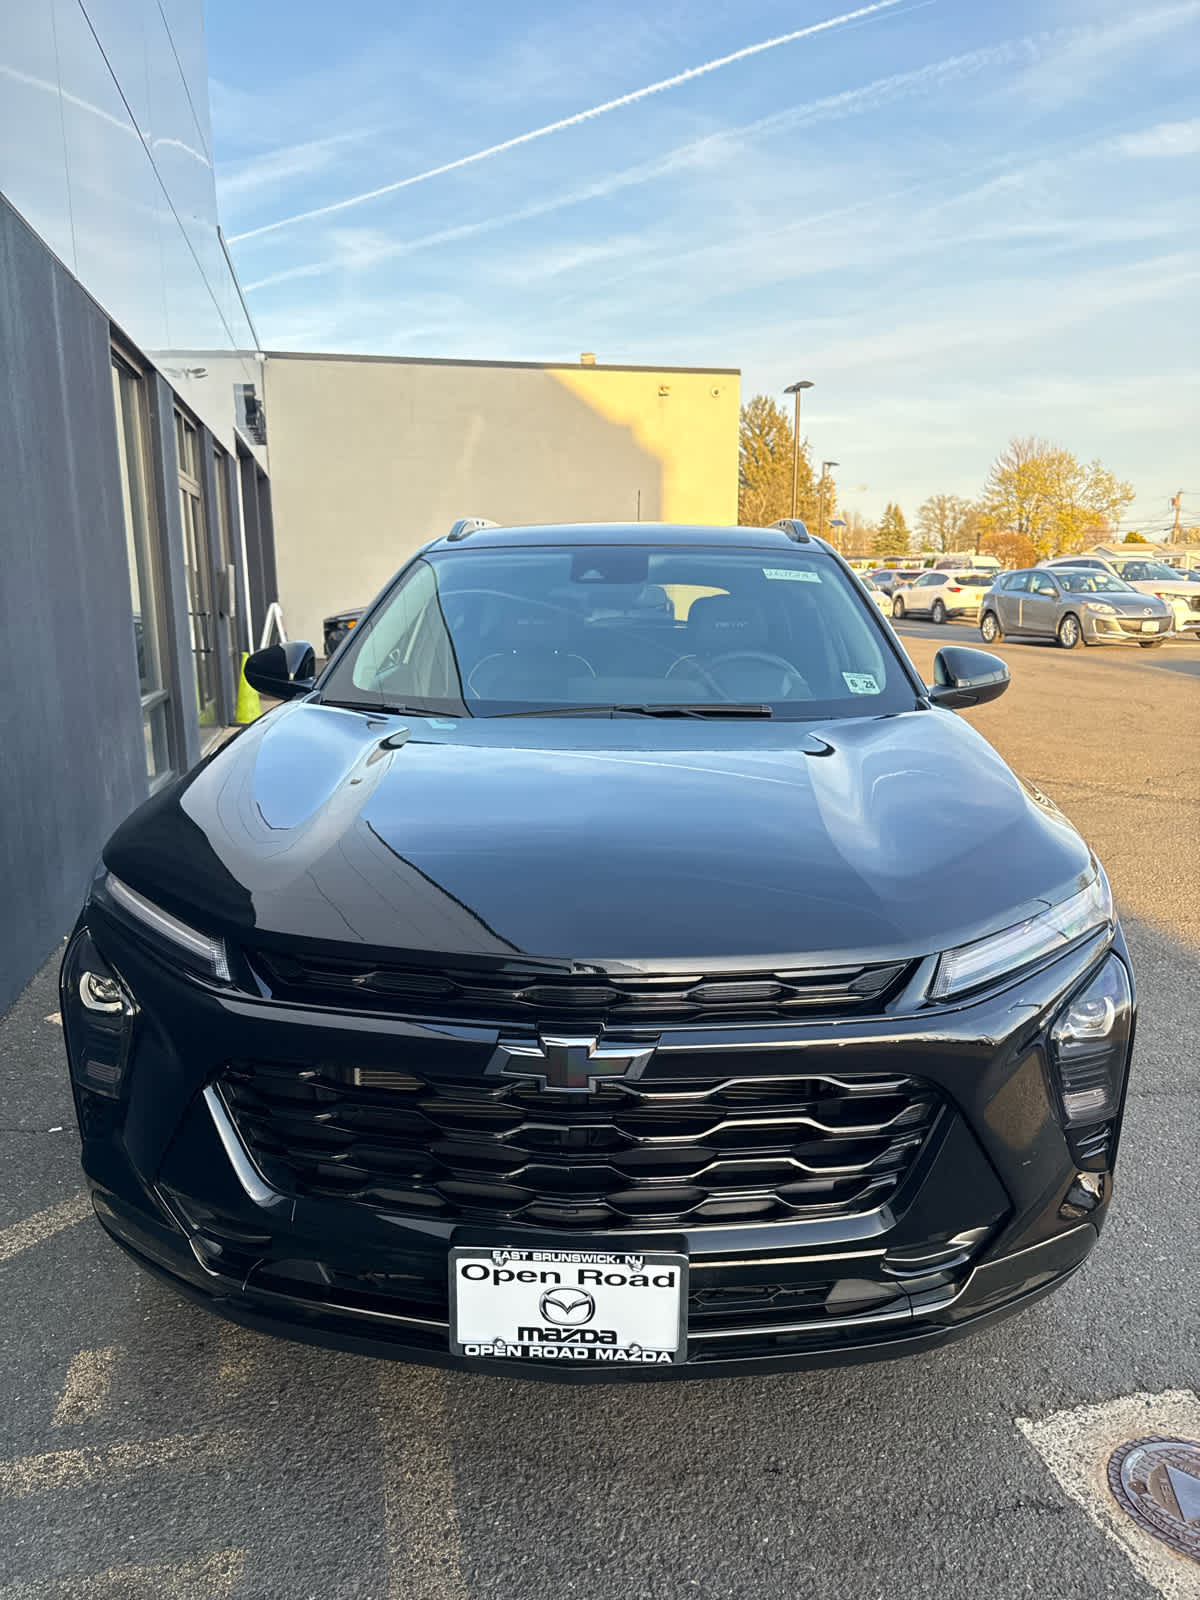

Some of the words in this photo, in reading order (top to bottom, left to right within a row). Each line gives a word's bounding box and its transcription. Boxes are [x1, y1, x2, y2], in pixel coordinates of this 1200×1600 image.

[492, 1251, 528, 1261] EAST
[624, 1255, 643, 1265] NJ
[461, 1264, 561, 1286] Open
[577, 1268, 675, 1288] Road
[518, 1326, 617, 1345] mazda
[465, 1344, 522, 1357] OPEN
[529, 1347, 588, 1360] ROAD
[595, 1350, 673, 1364] MAZDA
